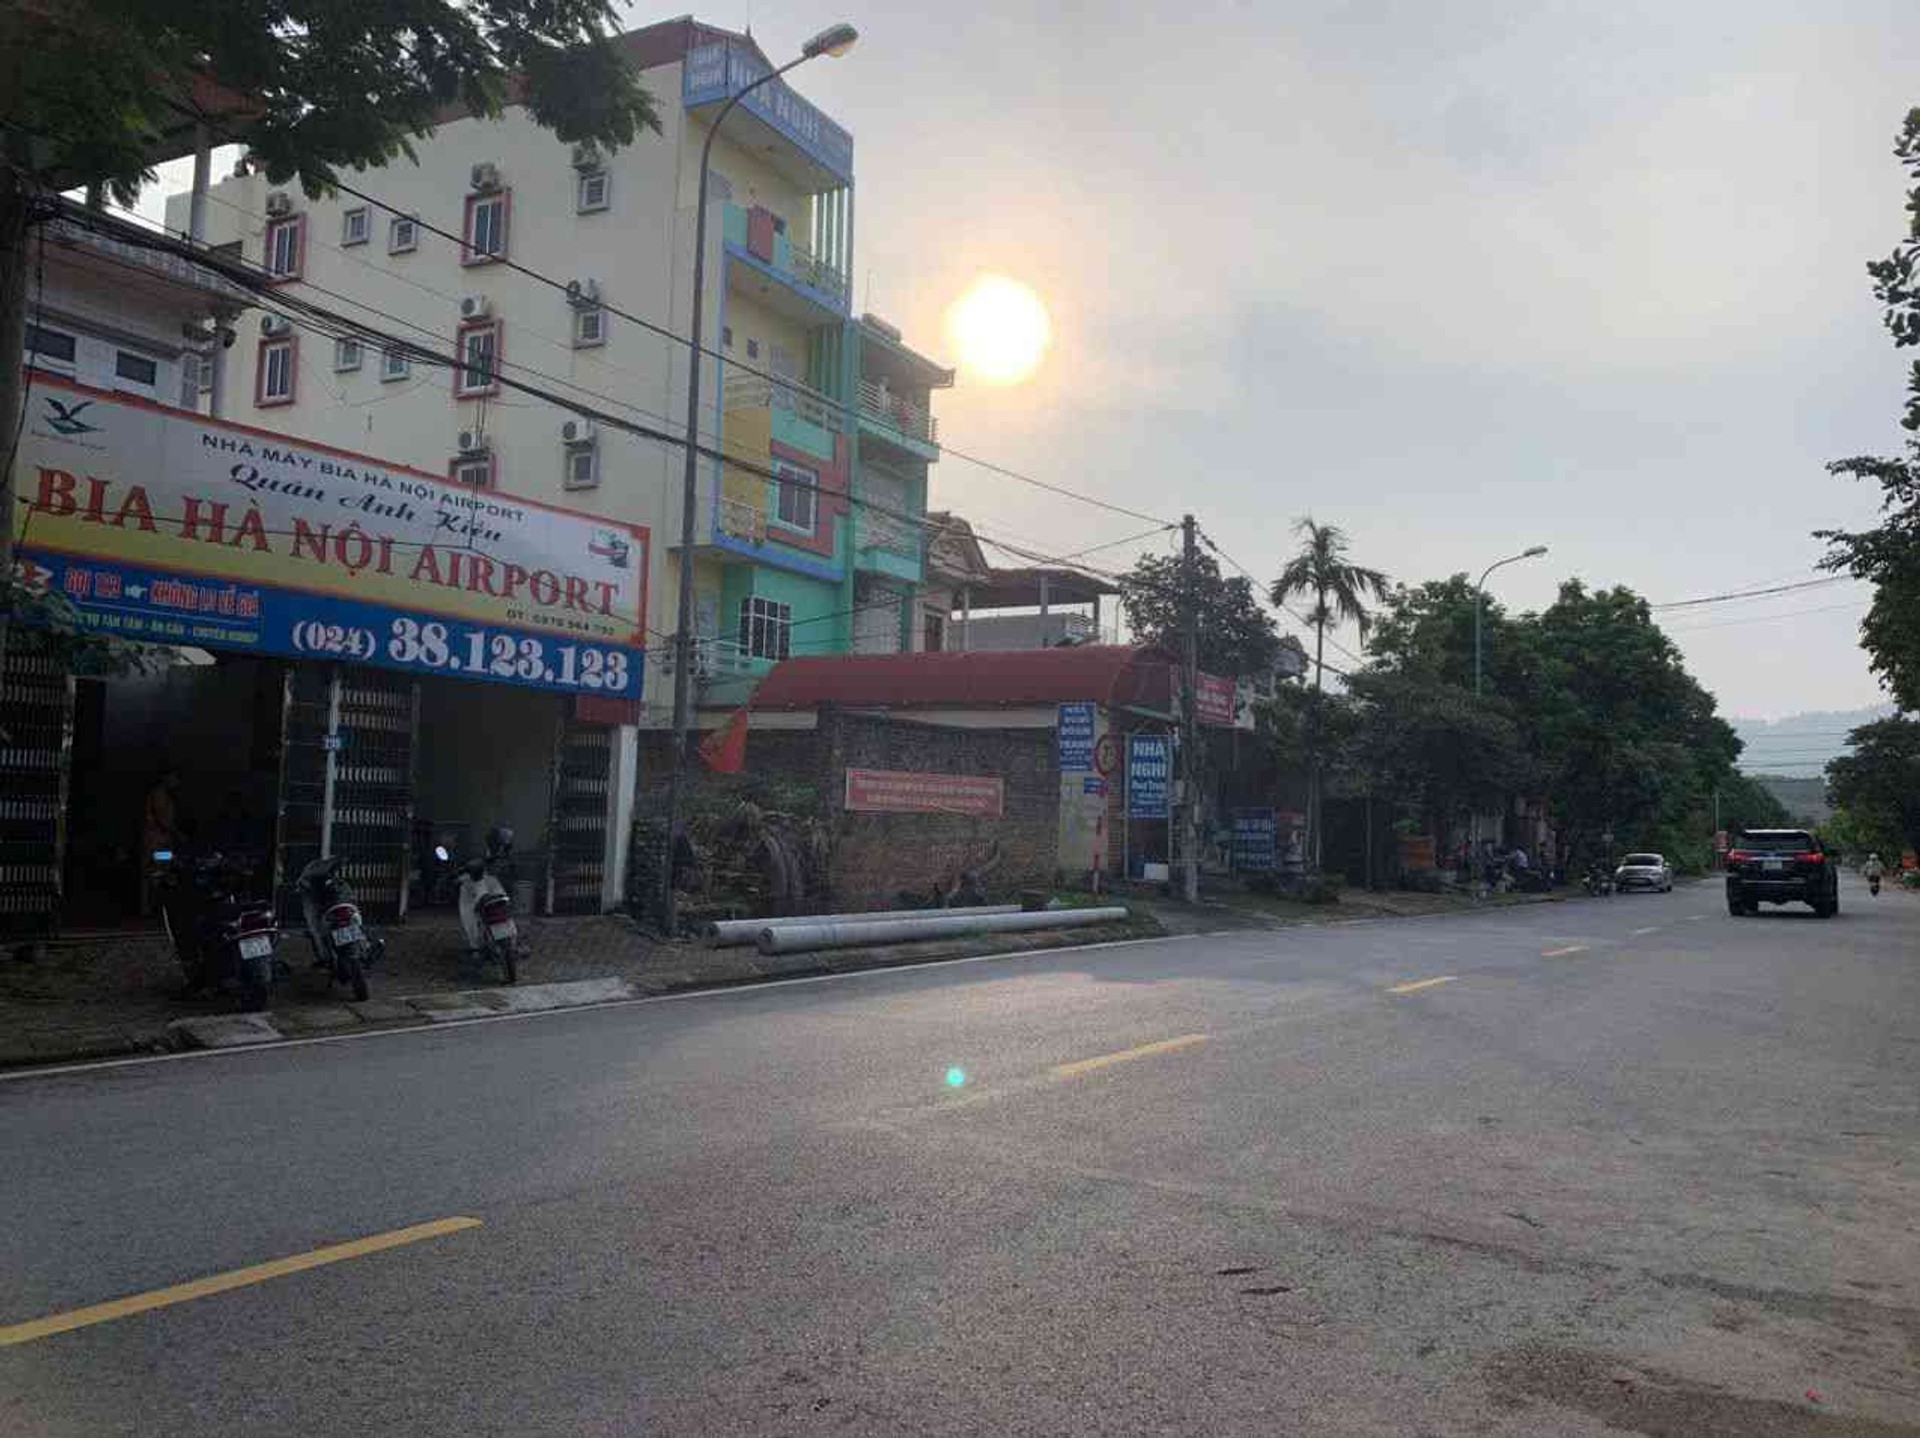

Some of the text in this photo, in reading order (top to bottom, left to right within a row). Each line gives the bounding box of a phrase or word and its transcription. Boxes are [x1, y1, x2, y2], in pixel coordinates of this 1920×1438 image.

[33, 464, 621, 617] BIA HÀ NỘI AIRPORT
[290, 616, 629, 691] (024) 38.123.123
